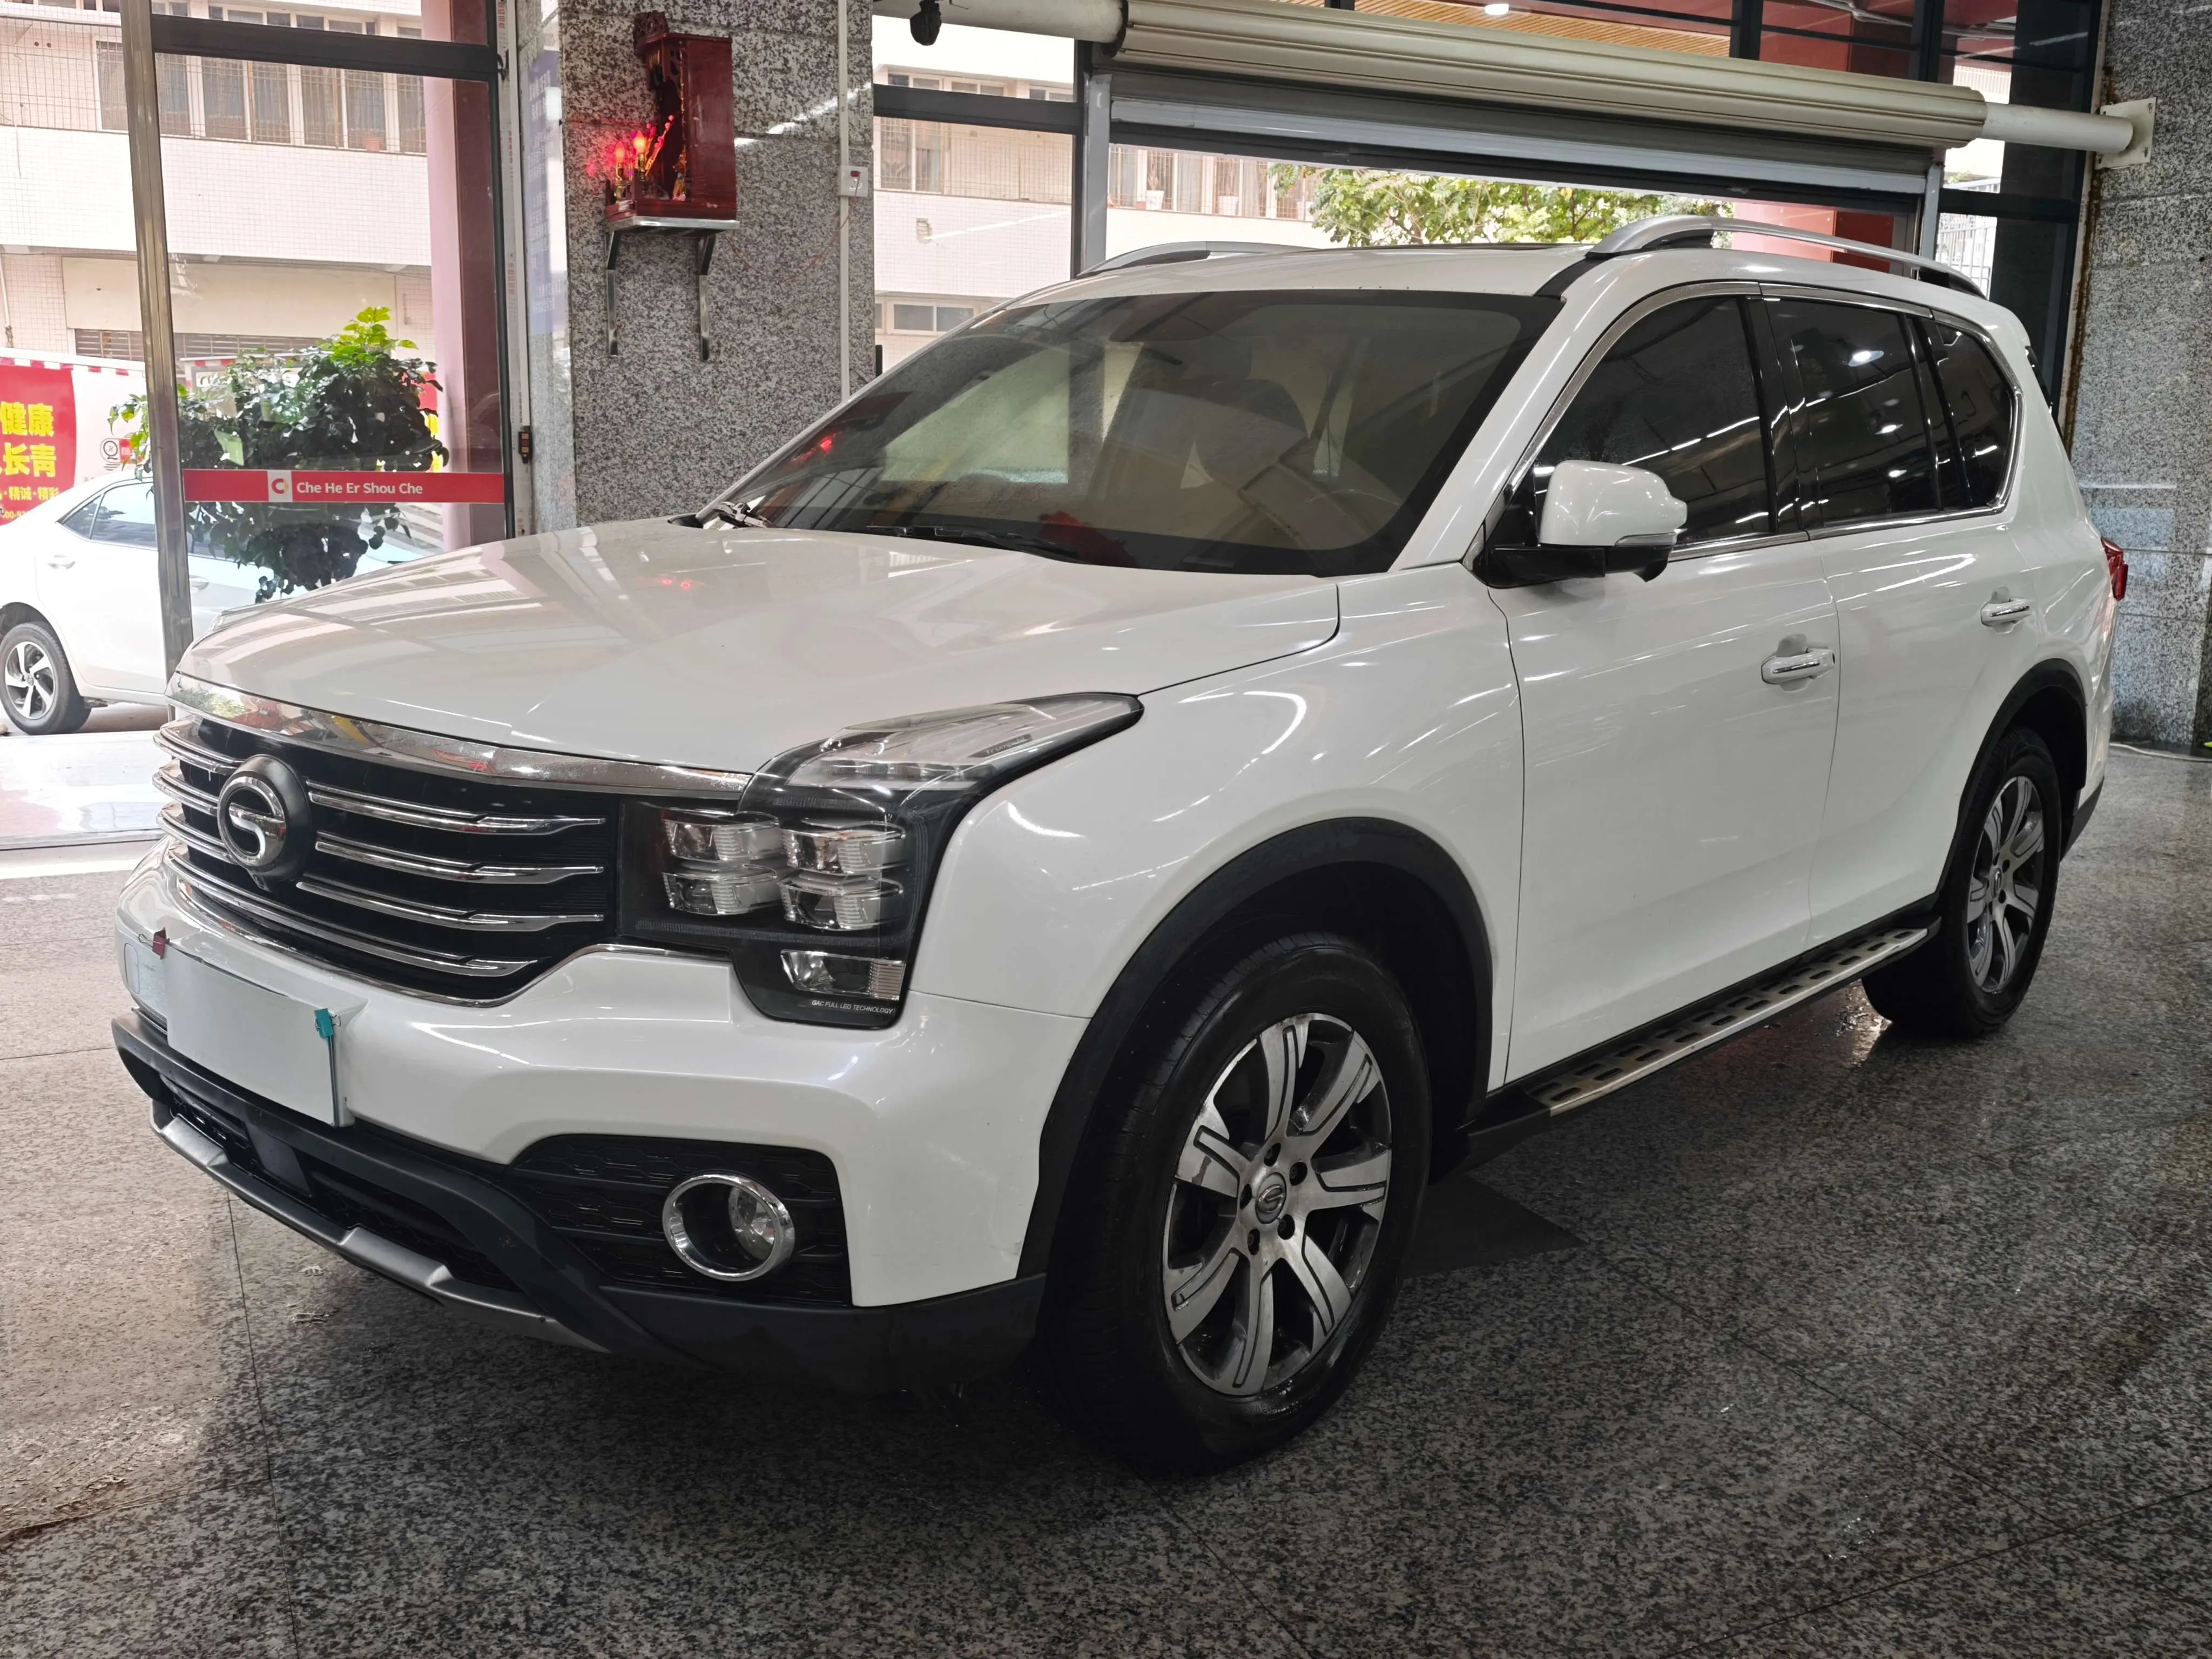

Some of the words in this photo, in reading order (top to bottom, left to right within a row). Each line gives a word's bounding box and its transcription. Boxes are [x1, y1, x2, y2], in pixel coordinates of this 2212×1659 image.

[0, 442, 56, 477] 长青
[296, 482, 322, 493] Che
[325, 483, 342, 493] He
[346, 483, 360, 494] Er
[363, 482, 395, 494] Shou
[399, 482, 423, 494] Che
[853, 1004, 893, 1014] TECHNOLOGY
